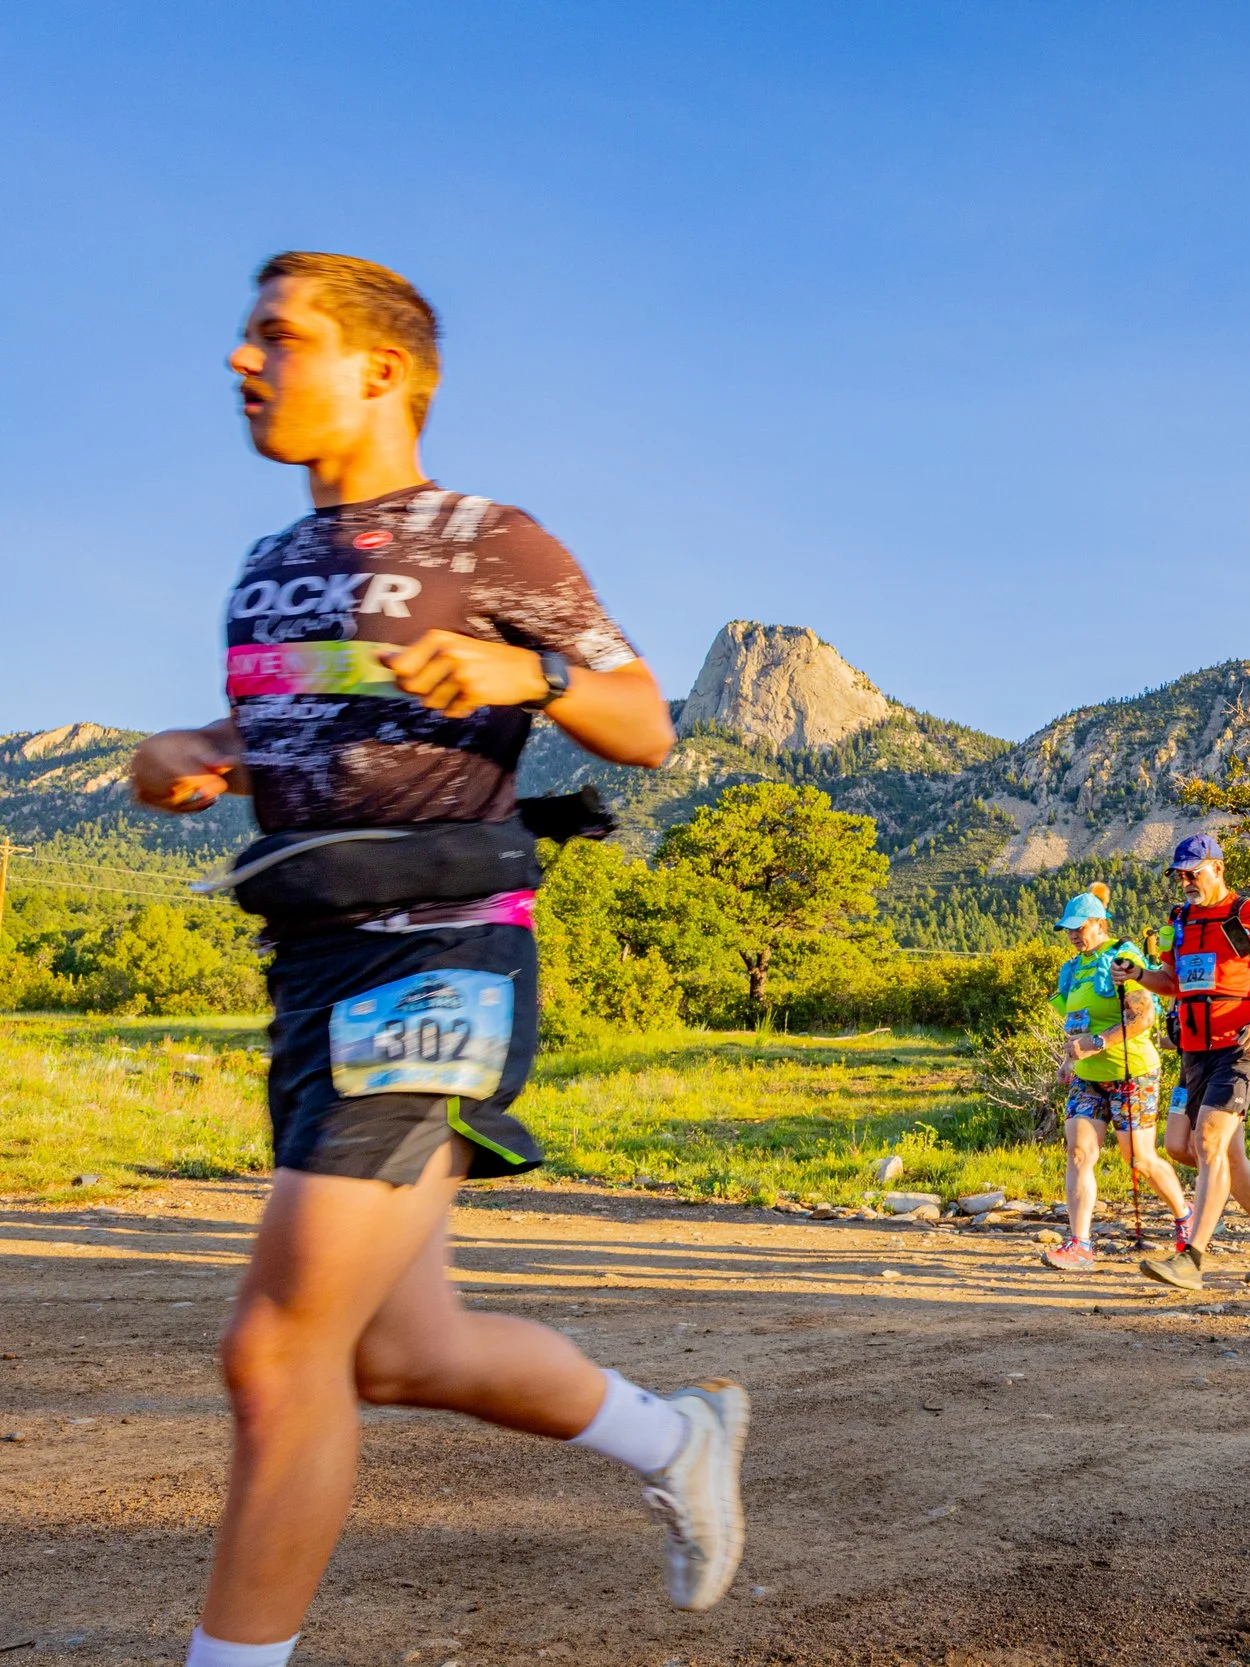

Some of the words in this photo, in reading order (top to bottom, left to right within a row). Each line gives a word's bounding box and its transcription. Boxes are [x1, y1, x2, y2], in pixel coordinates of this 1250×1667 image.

[228, 572, 423, 620] OCKR
[1187, 967, 1206, 983] 242
[379, 1017, 471, 1061] 302
